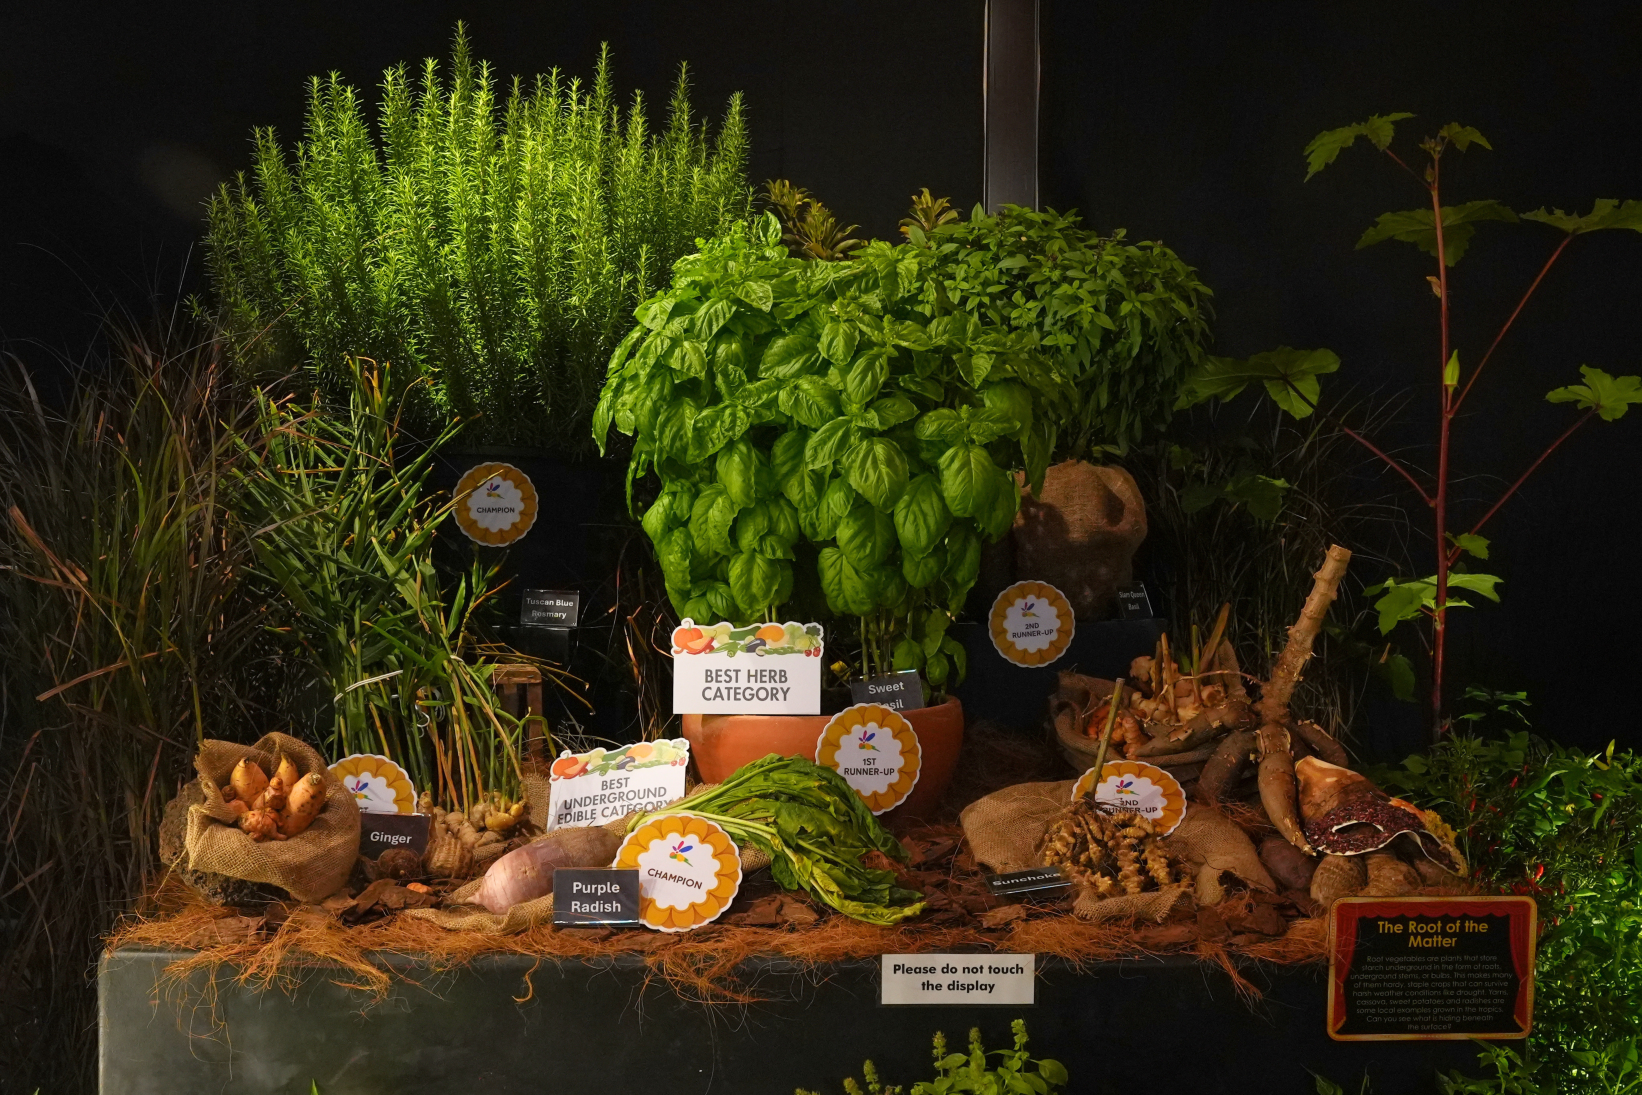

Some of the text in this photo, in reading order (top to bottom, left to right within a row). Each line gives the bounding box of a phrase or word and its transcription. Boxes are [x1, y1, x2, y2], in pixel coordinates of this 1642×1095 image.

[476, 506, 515, 514] CHAMPION
[526, 597, 574, 607] Tuscan Blue
[1025, 622, 1040, 630] 2ND
[1012, 628, 1054, 638] RUNNER-UP
[704, 669, 788, 684] BEST HERB
[701, 686, 791, 702] CATEGORY
[868, 681, 905, 694] Sweet
[862, 758, 877, 766] 1ST
[843, 767, 895, 776] RUNNER-UP
[601, 777, 631, 791] BEST
[564, 786, 667, 811] UNDERGROUND
[557, 808, 597, 825] EDIBLE
[370, 831, 413, 846] Ginger
[647, 868, 703, 890] CHAMPION
[992, 873, 1061, 886] Sunchoke
[572, 881, 621, 897] Purple
[571, 901, 621, 914] Radish
[1378, 920, 1489, 933] The Root of the
[1408, 936, 1457, 947] Matter
[893, 963, 1024, 975] Please do not touch
[921, 980, 996, 994] the display
